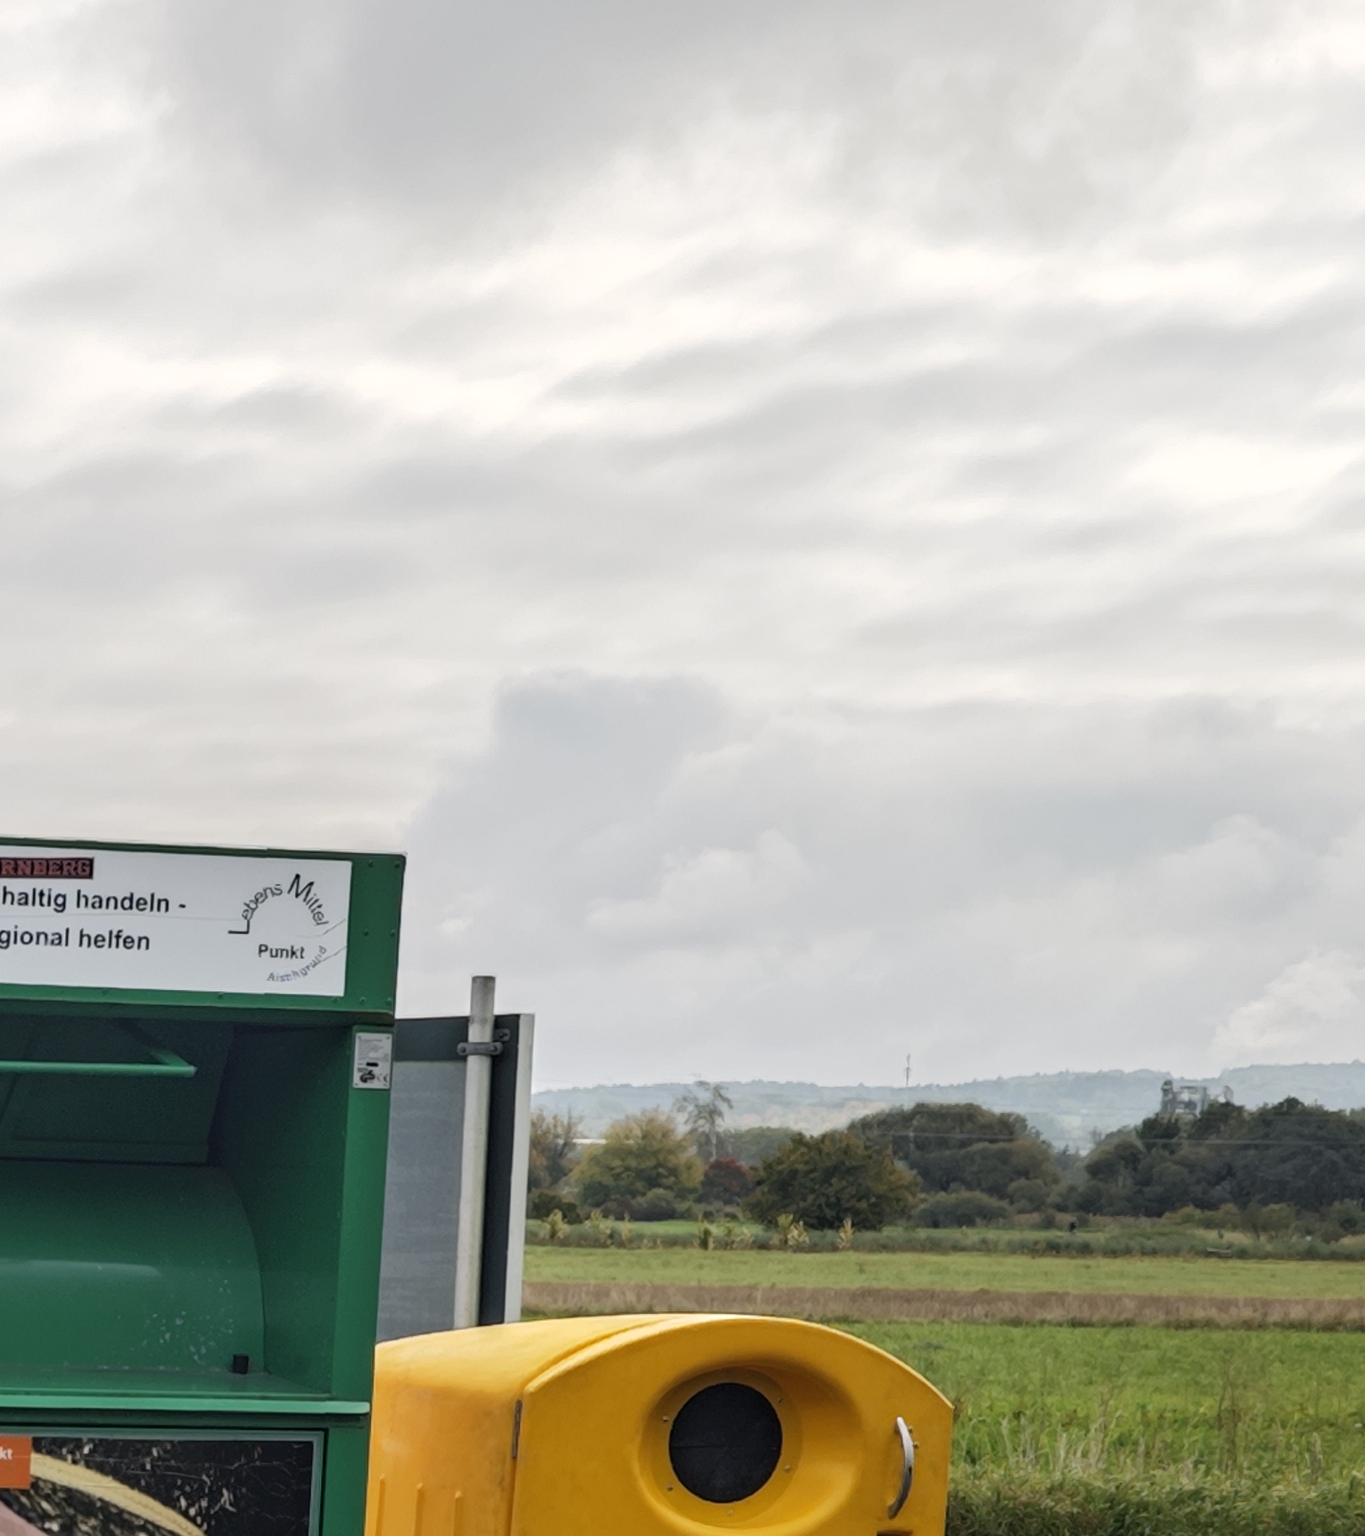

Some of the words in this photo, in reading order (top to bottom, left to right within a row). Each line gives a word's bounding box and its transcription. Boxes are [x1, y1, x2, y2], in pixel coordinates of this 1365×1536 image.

[75, 889, 170, 913] handeln
[78, 928, 150, 951] helfen
[258, 943, 306, 960] Punkt
